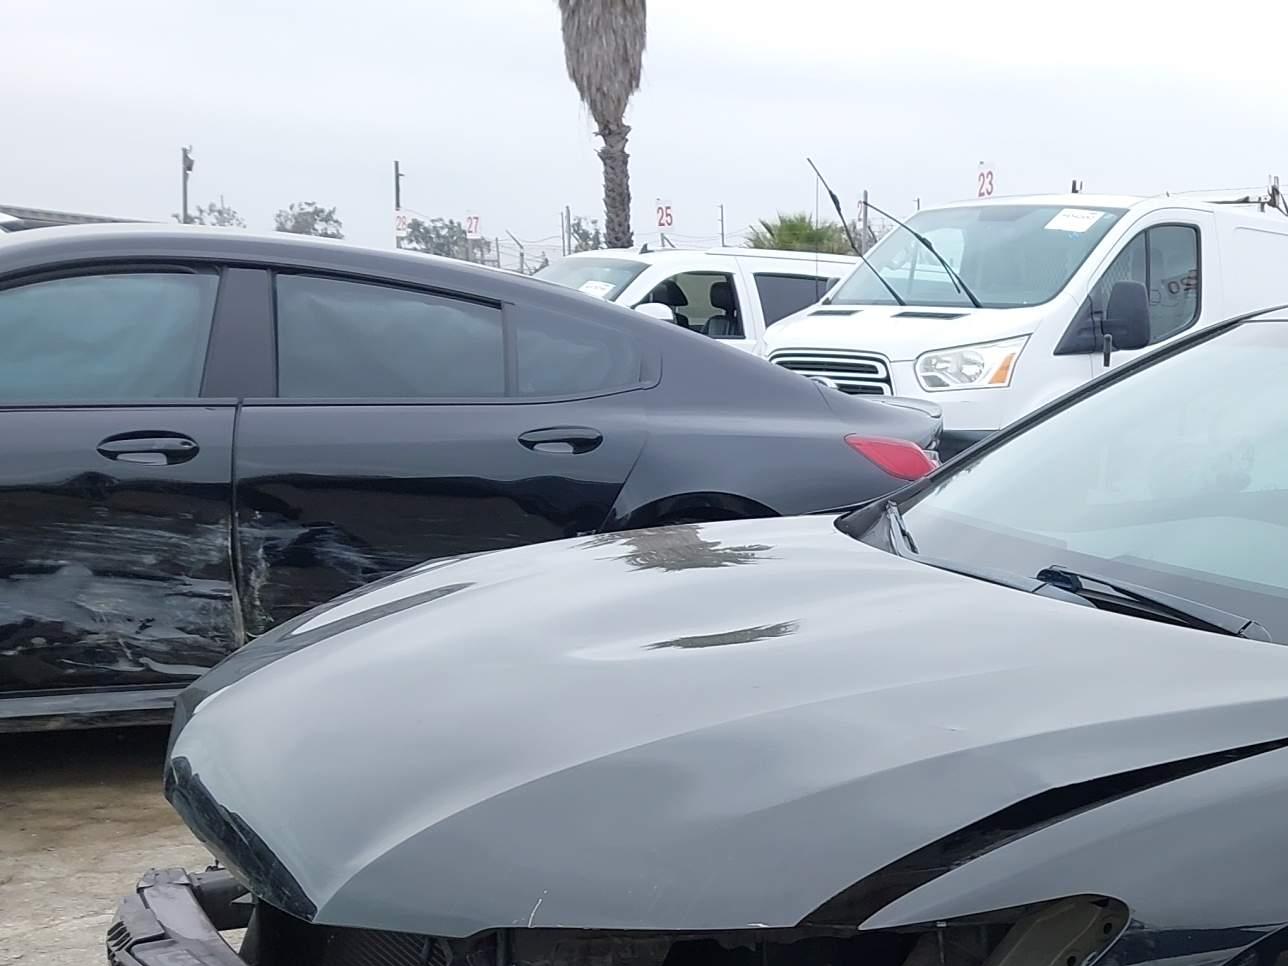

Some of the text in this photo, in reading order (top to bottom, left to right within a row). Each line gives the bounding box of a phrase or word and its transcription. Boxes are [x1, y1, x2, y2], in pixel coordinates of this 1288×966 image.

[978, 170, 994, 197] 23
[466, 216, 480, 233] 27
[656, 205, 673, 227] 25
